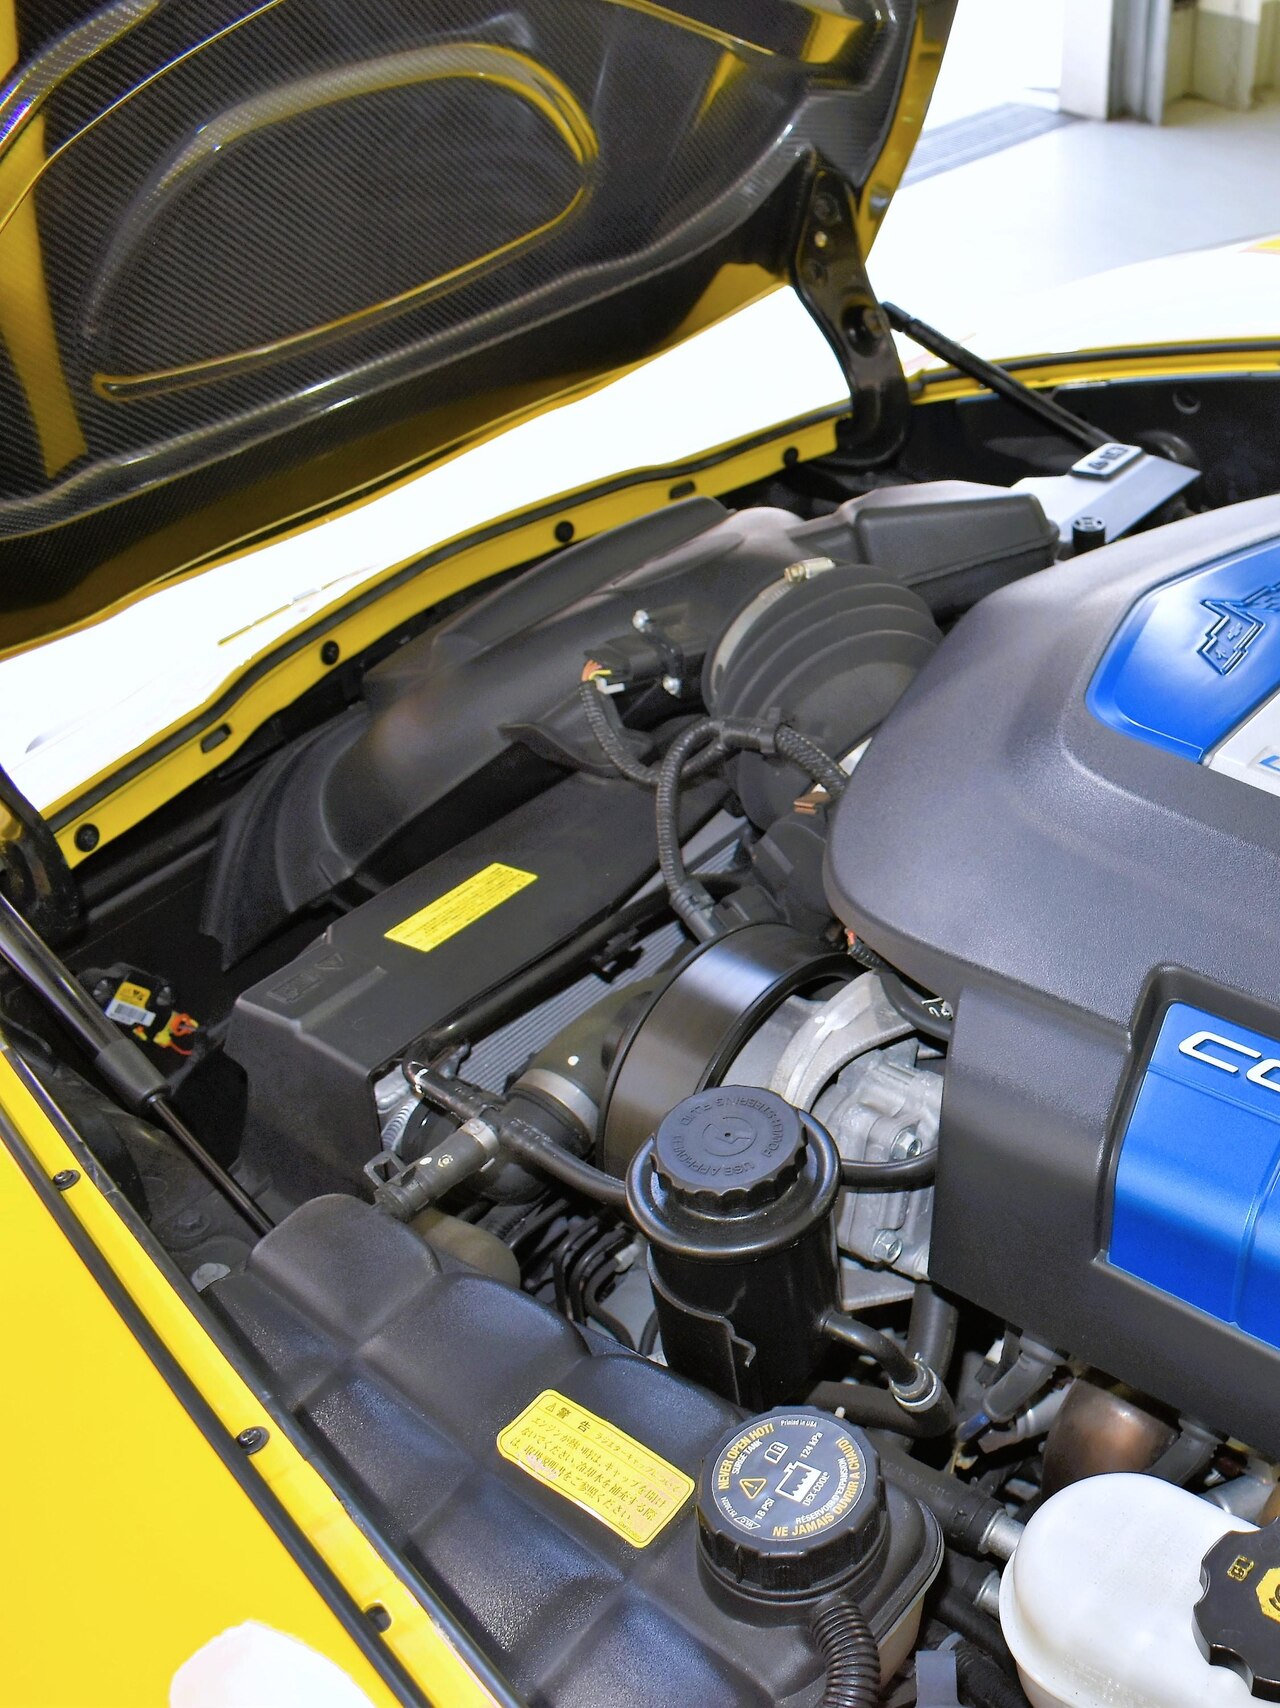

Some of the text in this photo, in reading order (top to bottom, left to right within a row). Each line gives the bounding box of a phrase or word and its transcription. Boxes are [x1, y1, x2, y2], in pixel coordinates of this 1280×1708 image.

[718, 1422, 775, 1490] NEVER OPEN HOT!
[732, 1439, 763, 1475] SURGE TANK
[800, 1445, 814, 1459] 124
[835, 1436, 860, 1471] CHAUD!
[761, 1497, 776, 1512] PSI
[832, 1481, 860, 1515] OUVRIR
[772, 1526, 789, 1537] NE
[791, 1512, 835, 1536] JAMAIS
